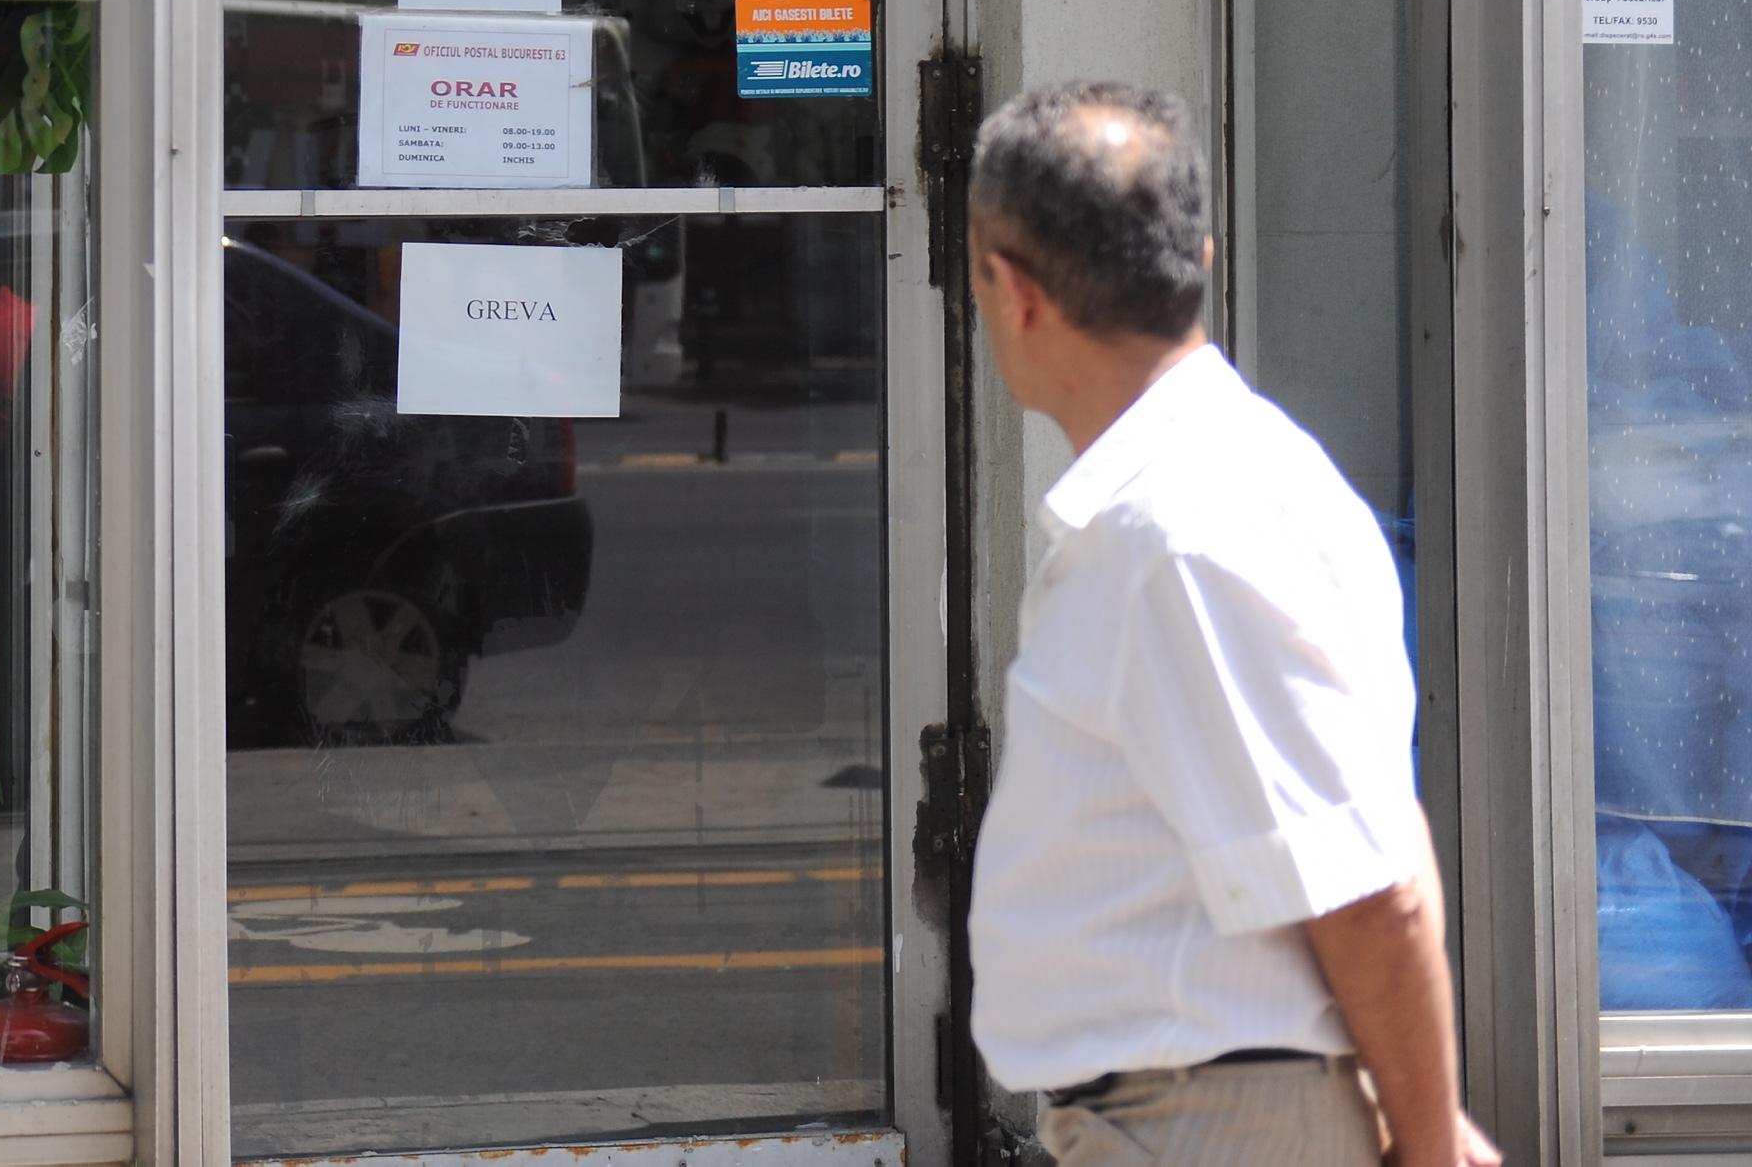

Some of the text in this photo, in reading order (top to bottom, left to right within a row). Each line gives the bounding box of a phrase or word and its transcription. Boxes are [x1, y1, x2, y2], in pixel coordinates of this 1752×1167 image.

[752, 7, 853, 21] AICI GASESTI BILETE
[1593, 16, 1658, 26] TEL/FAX: 9530
[423, 45, 566, 61] OFICIUL POSTAL BUCURESTI 63
[788, 60, 861, 79] Bilete.ro
[430, 80, 519, 98] ORAR
[430, 99, 519, 110] DE FUNCTIONARE
[399, 125, 421, 133] LUNI
[432, 126, 467, 134] VINERI:
[399, 139, 444, 148] SAMBATA:
[399, 153, 445, 162] DUMINICA
[502, 156, 535, 164] INCHIS
[466, 299, 557, 321] GREVA
